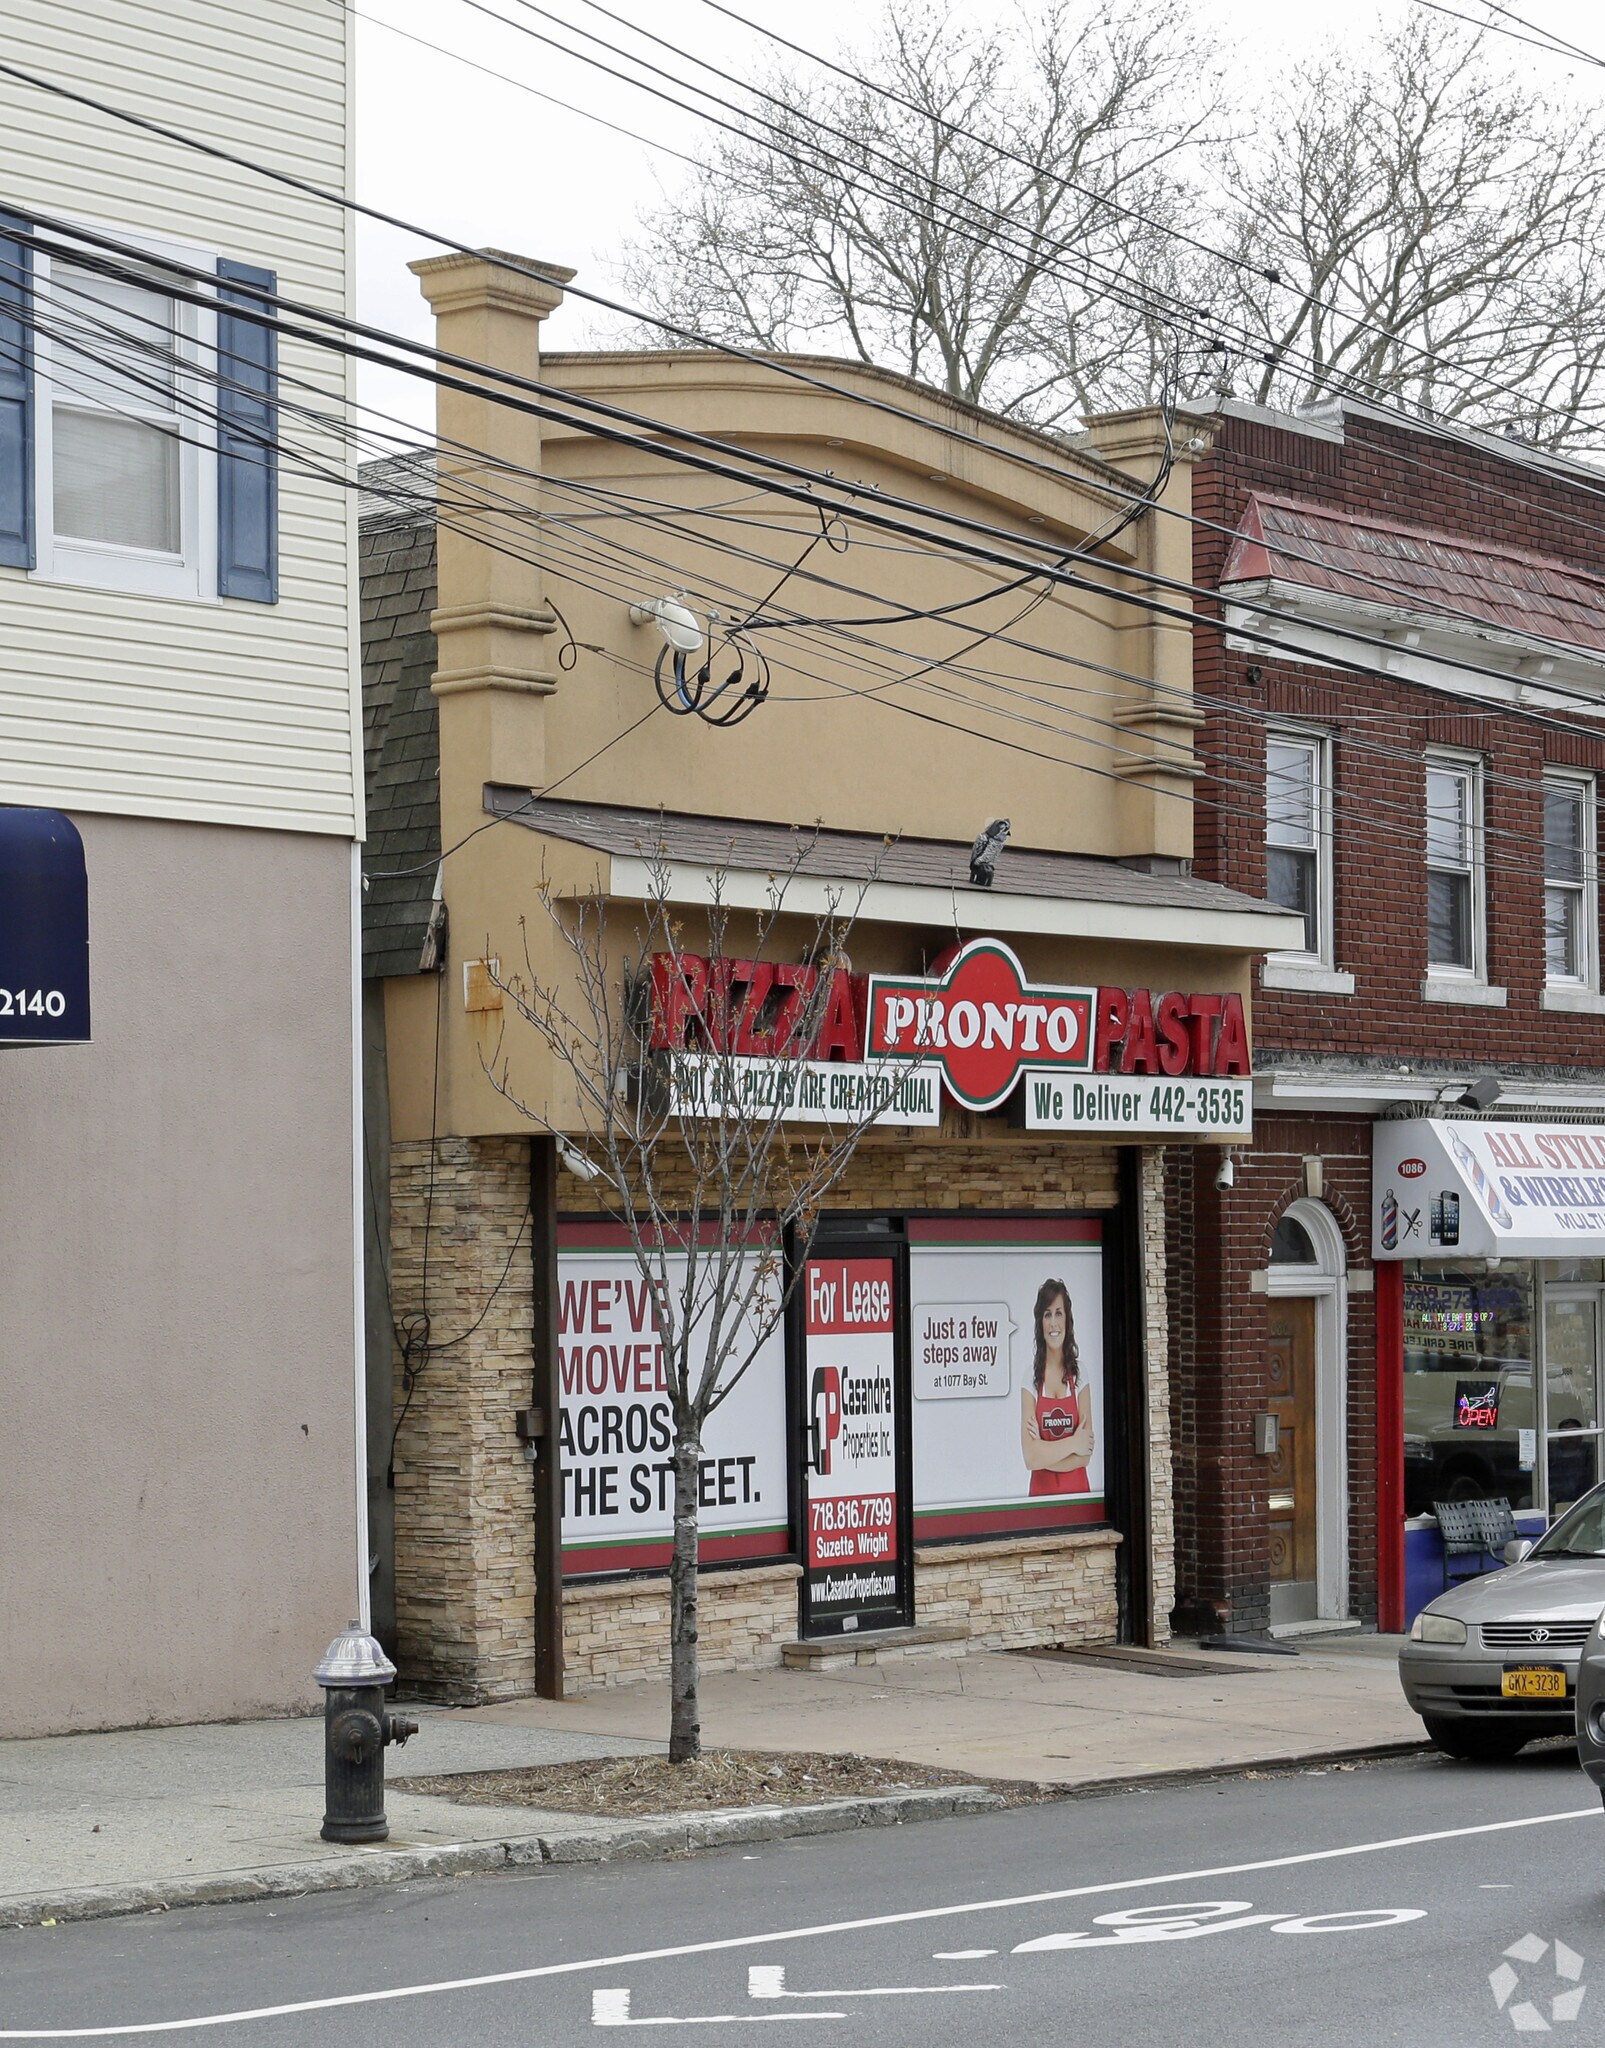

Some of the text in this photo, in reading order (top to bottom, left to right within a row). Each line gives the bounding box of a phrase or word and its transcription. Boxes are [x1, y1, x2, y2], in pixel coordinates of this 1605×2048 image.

[652, 953, 866, 1062] PIZZA
[883, 996, 1079, 1053] PRONTO
[1098, 986, 1251, 1076] PASTA
[799, 1073, 827, 1109] ARE
[829, 1074, 890, 1112] CREATED
[892, 1075, 934, 1117] EQUAL
[1033, 1082, 1244, 1125] We Deliver 442-3535
[1400, 1162, 1424, 1175] 1086
[1483, 1132, 1544, 1169] ALL
[557, 1280, 670, 1334] WE'VE
[810, 1267, 890, 1324] For Lease
[923, 1316, 998, 1340] Just a few
[1473, 1312, 1488, 1322] SOP
[923, 1343, 998, 1368] steps away
[841, 1364, 892, 1416] Casandra
[933, 1373, 989, 1389] at 1077 Bay St.
[559, 1403, 672, 1456] ACROS
[1044, 1418, 1071, 1427] PRONTO
[1459, 1407, 1497, 1426] OPEN
[842, 1422, 878, 1469] Properties
[560, 1456, 761, 1518] THE STEET.
[811, 1496, 892, 1532] 718.816.7799
[816, 1532, 889, 1559] Suzette Wright
[810, 1571, 896, 1603] www.CasandraProperties.com
[1508, 1674, 1560, 1691] GKX 3238
